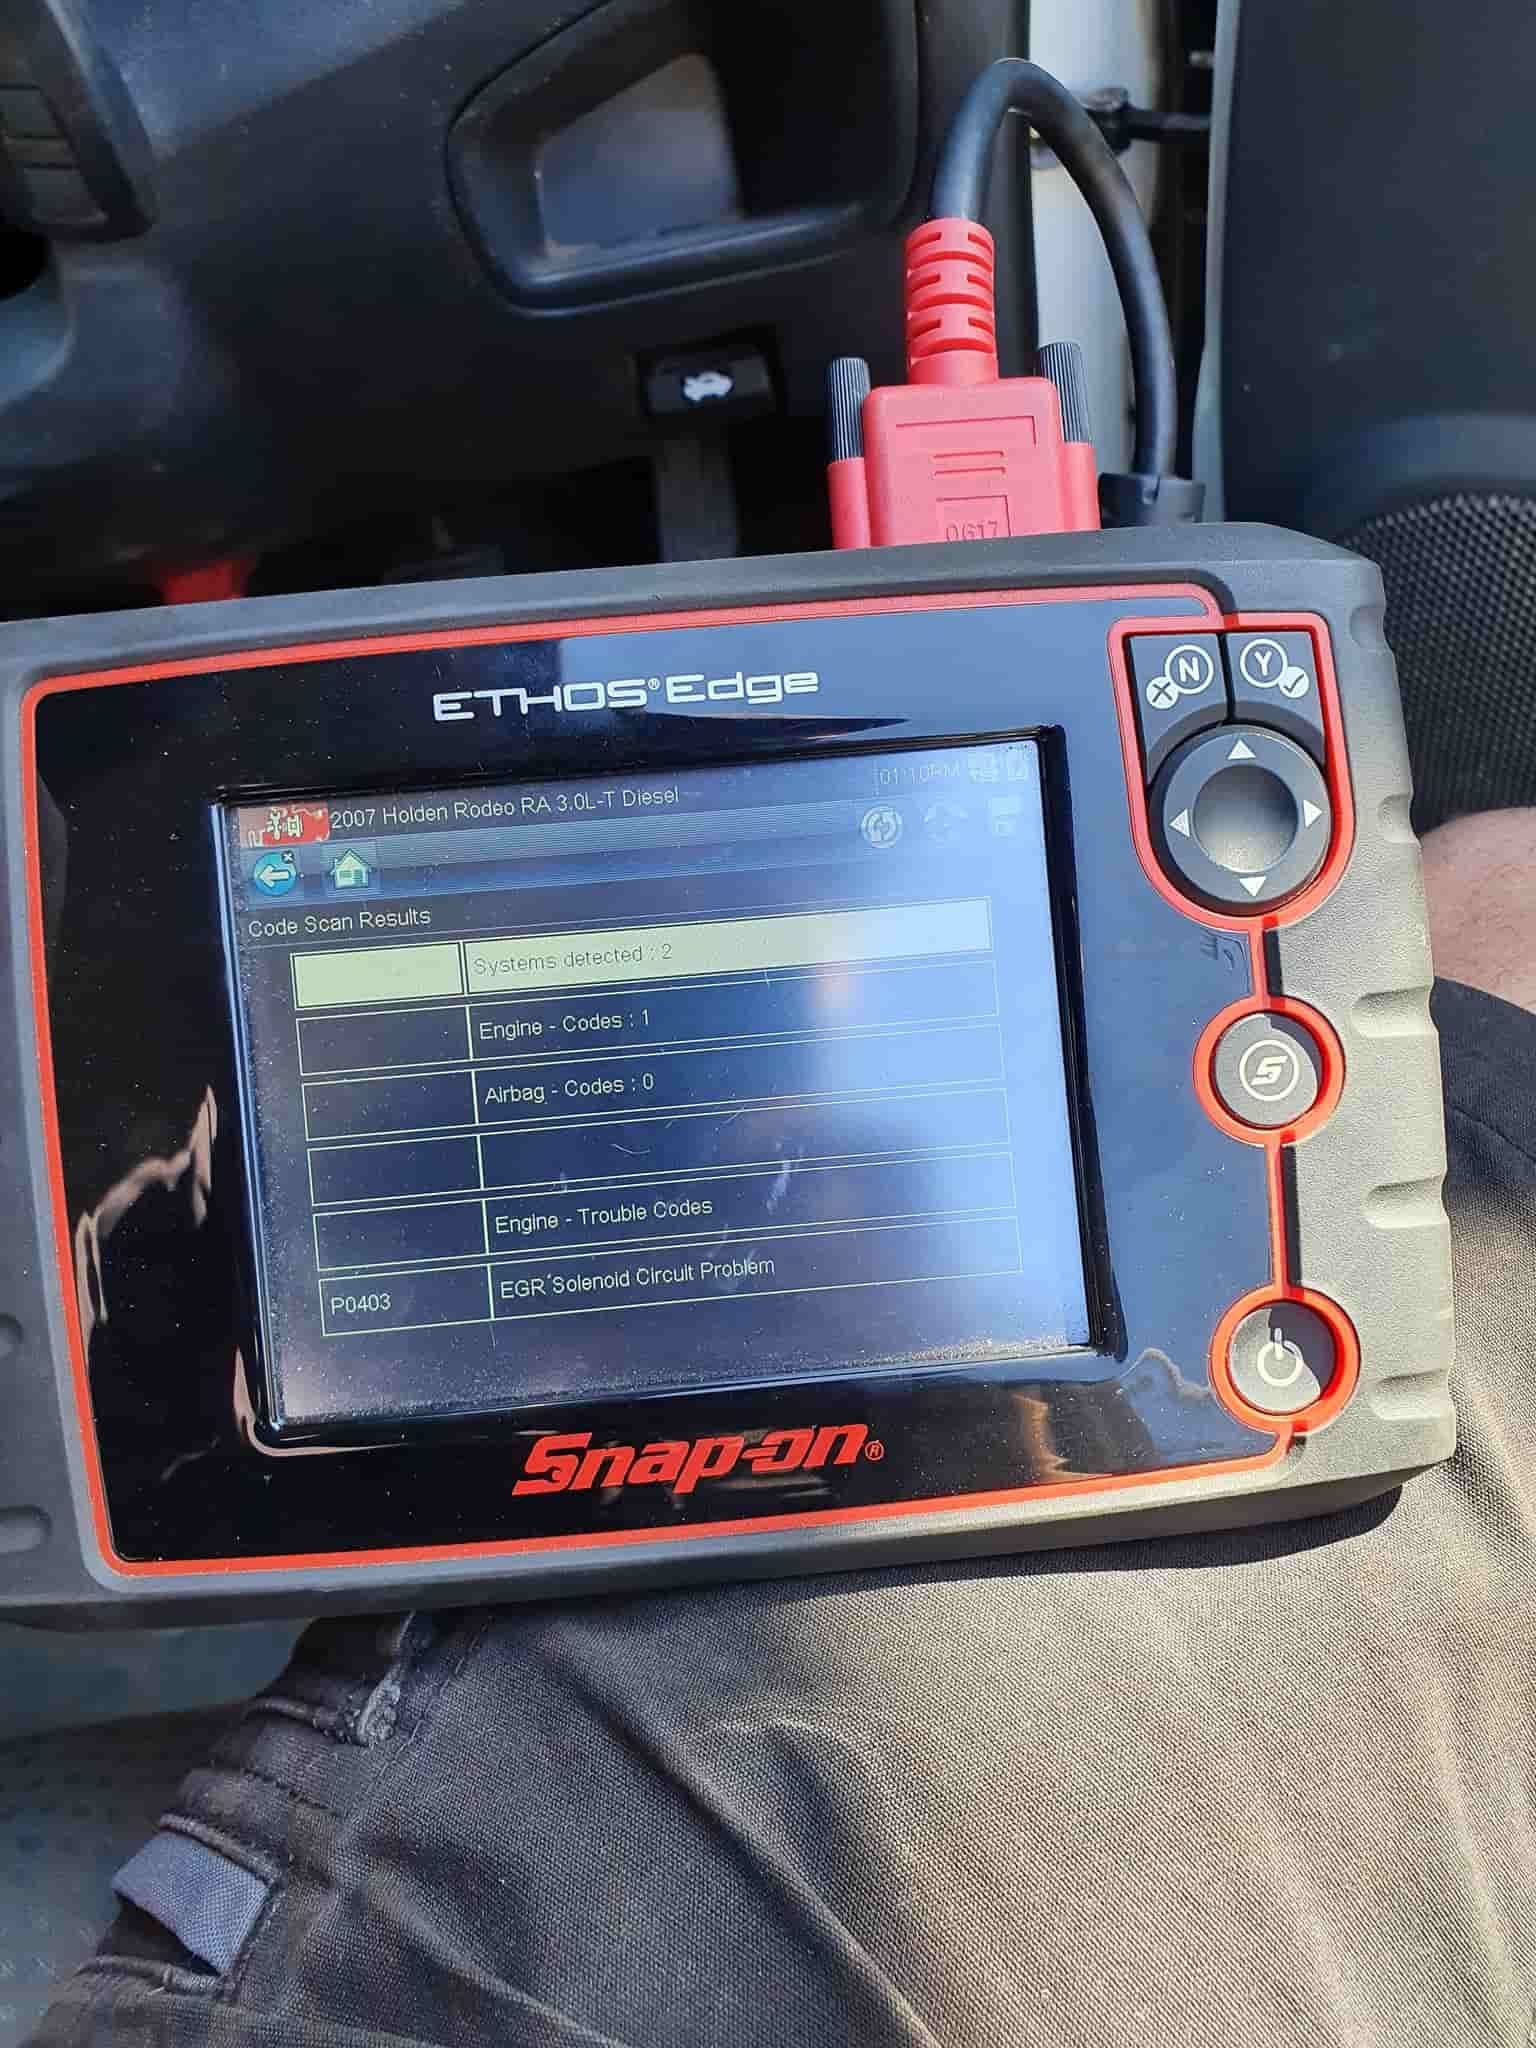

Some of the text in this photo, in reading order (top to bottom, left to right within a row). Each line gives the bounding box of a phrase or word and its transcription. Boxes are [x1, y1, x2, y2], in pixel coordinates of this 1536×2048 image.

[1178, 656, 1201, 683] N
[1254, 651, 1273, 677] Y
[665, 671, 820, 705] Edge
[330, 786, 680, 829] 2007 Holden Rodeo RA 3.0L-T Diesel
[248, 908, 432, 938] Code Scan Results
[473, 953, 557, 976] Systems
[563, 943, 643, 968] detected
[661, 943, 673, 960] 2
[479, 1020, 543, 1041] Engine
[562, 1012, 623, 1032] Codes
[641, 1008, 650, 1025] 1
[485, 1084, 545, 1105] Airbag
[564, 1075, 625, 1096] Codes
[642, 1073, 654, 1090] 0
[495, 1213, 560, 1235] Engine
[577, 1202, 648, 1226] Trouble
[653, 1199, 713, 1219] Codes
[501, 1256, 776, 1300] EGR Solenoid Circuit Problem
[330, 1292, 392, 1315] P0403
